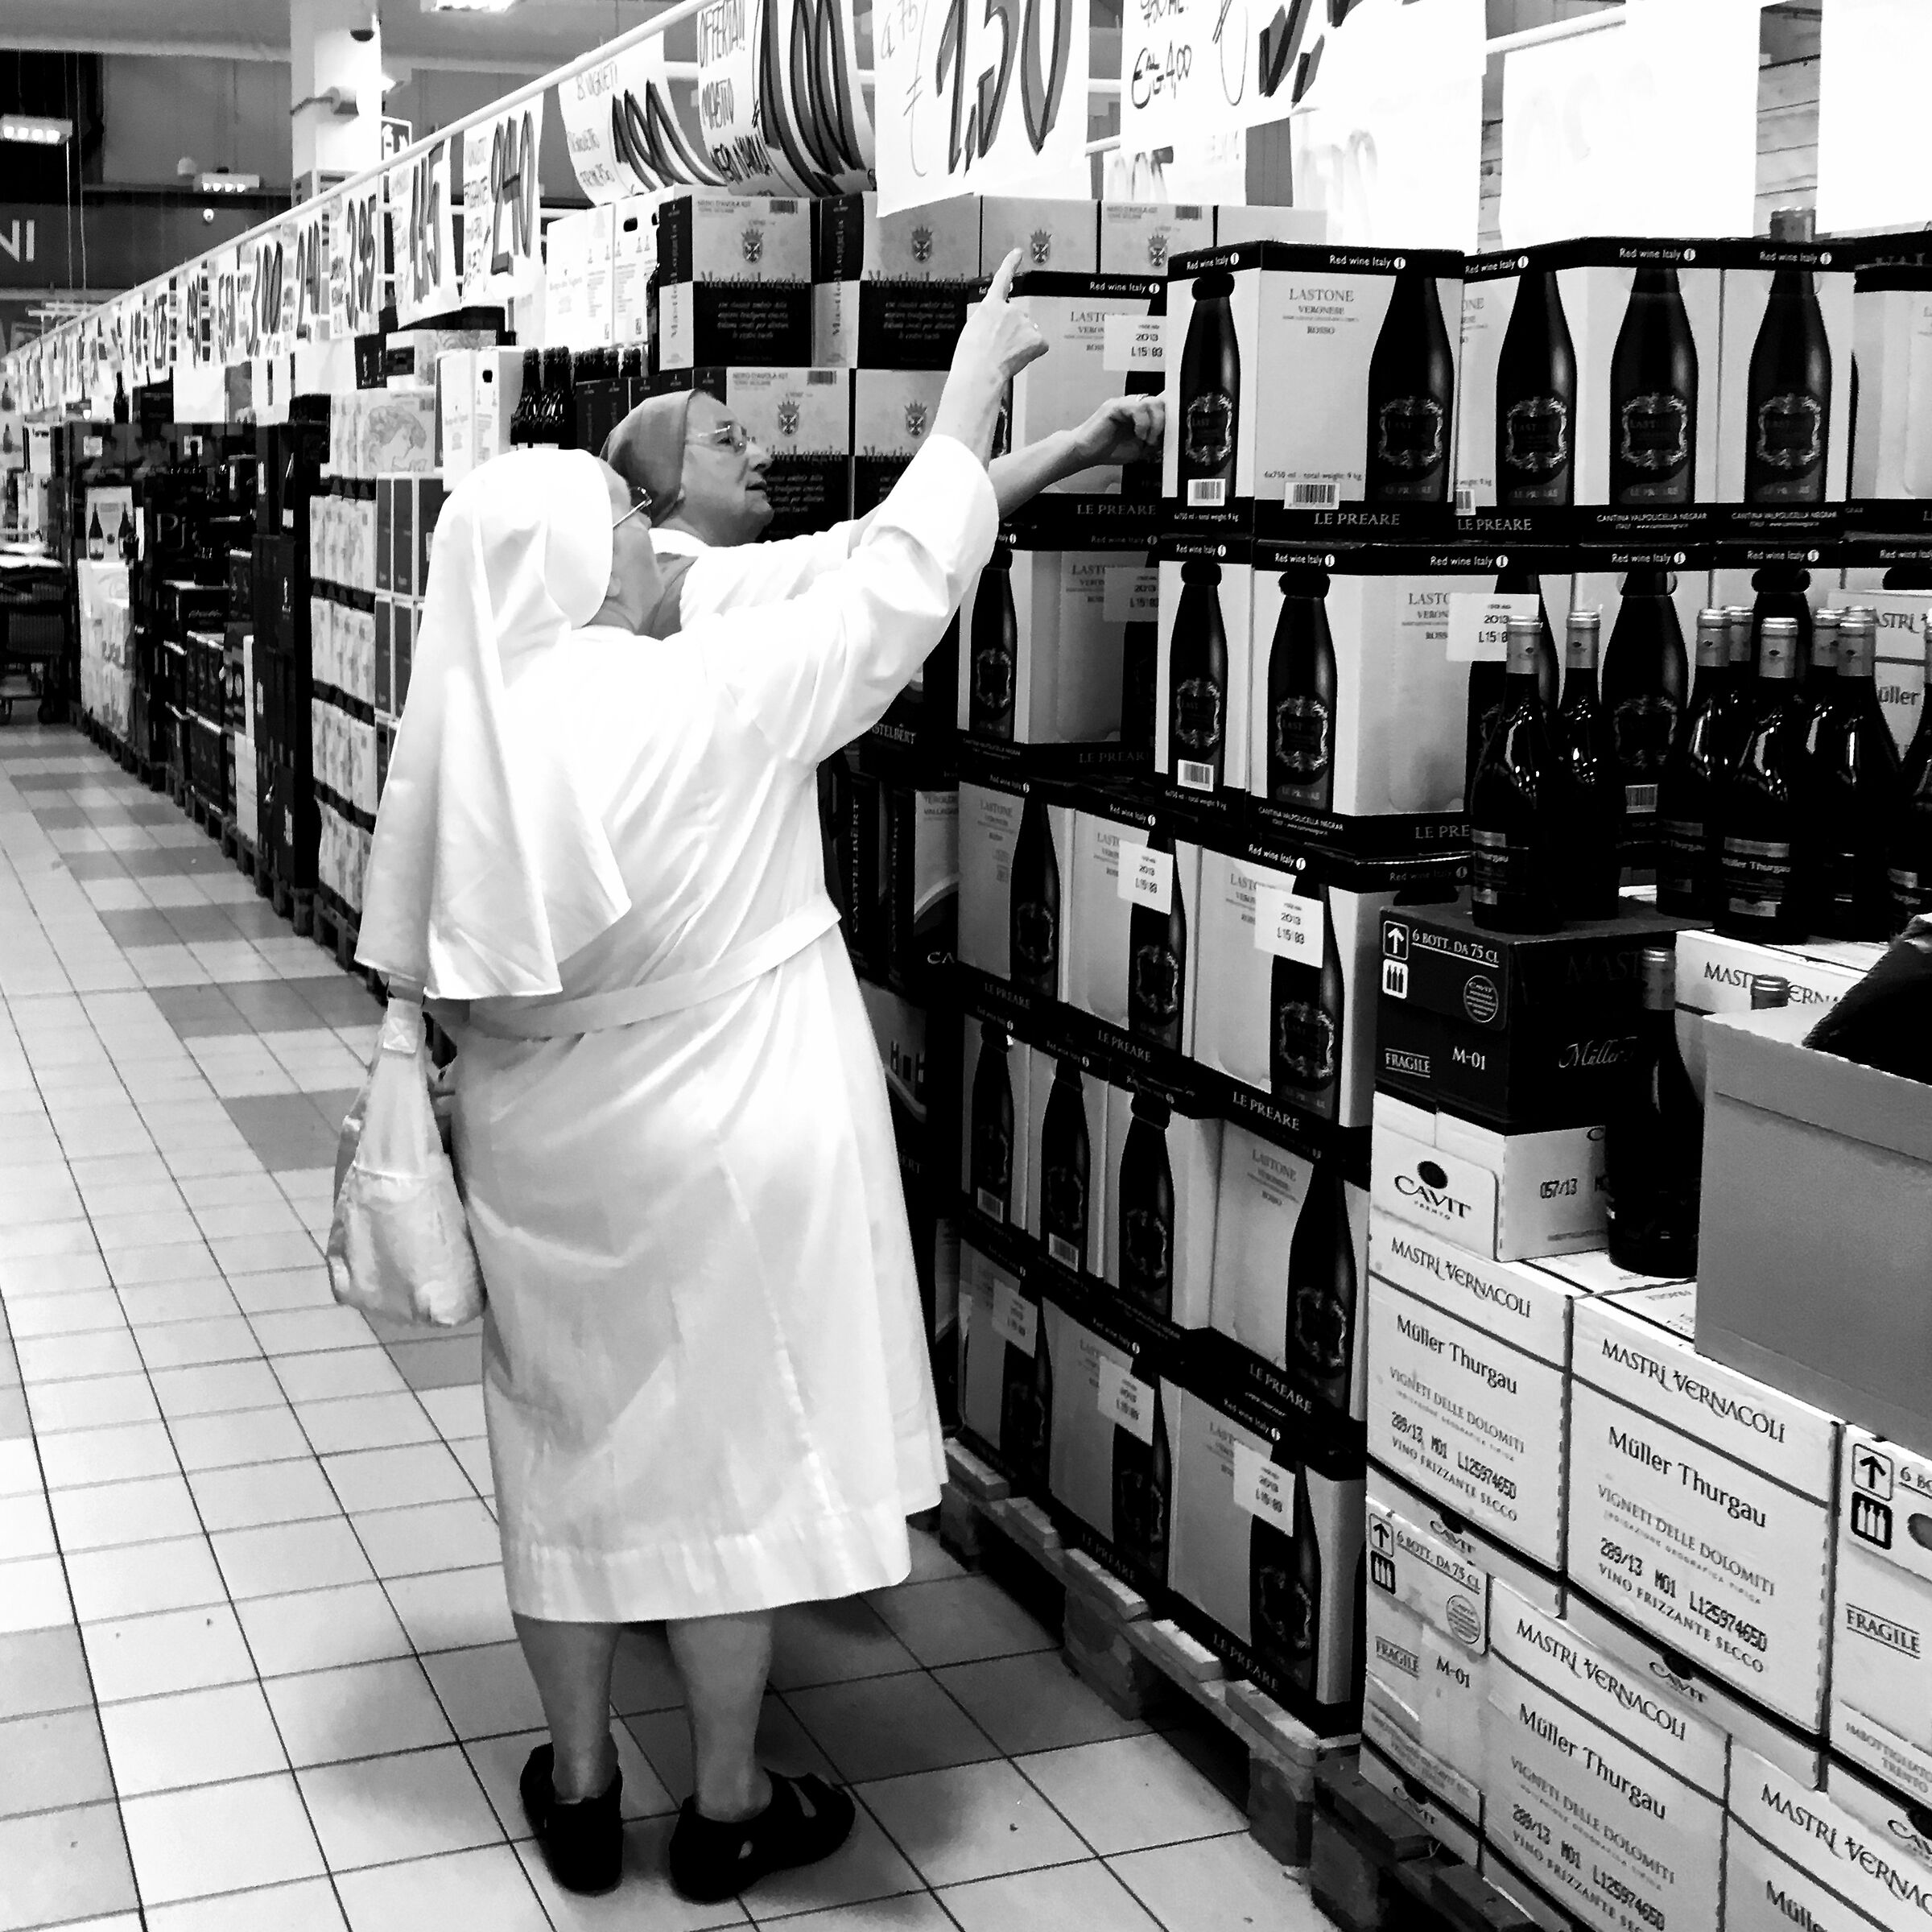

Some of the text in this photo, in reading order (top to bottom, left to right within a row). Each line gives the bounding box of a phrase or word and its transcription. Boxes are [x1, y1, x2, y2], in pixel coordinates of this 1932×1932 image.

[1187, 255, 1229, 270] Red wine Italy
[1329, 254, 1391, 268] Red wine Italy
[1465, 258, 1517, 275] Red wine Italy
[1619, 248, 1681, 261] Red wine Italy
[1759, 251, 1818, 264] Red wine Italy
[1089, 282, 1146, 294] Red wine Italy
[1288, 288, 1355, 303] LASTONE
[1135, 333, 1159, 341] 2013
[1076, 504, 1158, 515] LE PREARE
[1313, 513, 1401, 526] LE PREARE
[1457, 518, 1533, 531] LE PREARE
[1176, 543, 1187, 554] Red
[1189, 545, 1203, 554] wine
[1275, 552, 1323, 567] Red wine Italy
[1612, 553, 1671, 564] Red wine Italy
[1747, 550, 1764, 560] Red
[1765, 551, 1785, 560] wine
[1430, 555, 1493, 568] Red wine Italy
[1484, 615, 1509, 624] 2013
[1438, 824, 1471, 838] PRE
[1249, 844, 1296, 868] Red wine Italy
[1280, 911, 1302, 926] 2013
[1412, 929, 1501, 964] 6 BOTT. DA 75 CL
[1703, 961, 1753, 989] MAST
[1112, 1035, 1152, 1064] PREARE
[1451, 1046, 1486, 1071] M-01
[1385, 1052, 1431, 1075] FRAGILE
[1232, 1091, 1300, 1132] LE PREARE
[1393, 1174, 1472, 1220] CAVIT
[1391, 1236, 1531, 1319] MASTRI VERNACOLI
[1397, 1314, 1518, 1394] Müller Thurgau
[1249, 1363, 1313, 1414] LE PREARE
[1602, 1338, 1785, 1443] MASTRI VERNACOLI
[1389, 1367, 1431, 1400] VIGNETI
[1434, 1393, 1464, 1420] DELLE
[1467, 1410, 1525, 1454] DOLOMITI
[1392, 1435, 1518, 1522] VINO FRIZZANTE SECCO
[1608, 1426, 1766, 1528] Müller Thurgau
[1900, 1467, 1912, 1482] 6
[1598, 1484, 1775, 1596] VIGNETI DELLE DOLOMITI
[1598, 1562, 1765, 1673] VINO FRIZZANTE SECCO
[1846, 1609, 1921, 1653] FRAGILE
[1436, 1655, 1471, 1688] M-01
[1516, 1618, 1686, 1741] MASTRI VERNACOLI
[1519, 1702, 1579, 1757] Müller
[1583, 1745, 1666, 1820] Thurgau
[1761, 1783, 1843, 1860] MASTRI
[1603, 1824, 1675, 1885] DOLOMITI
